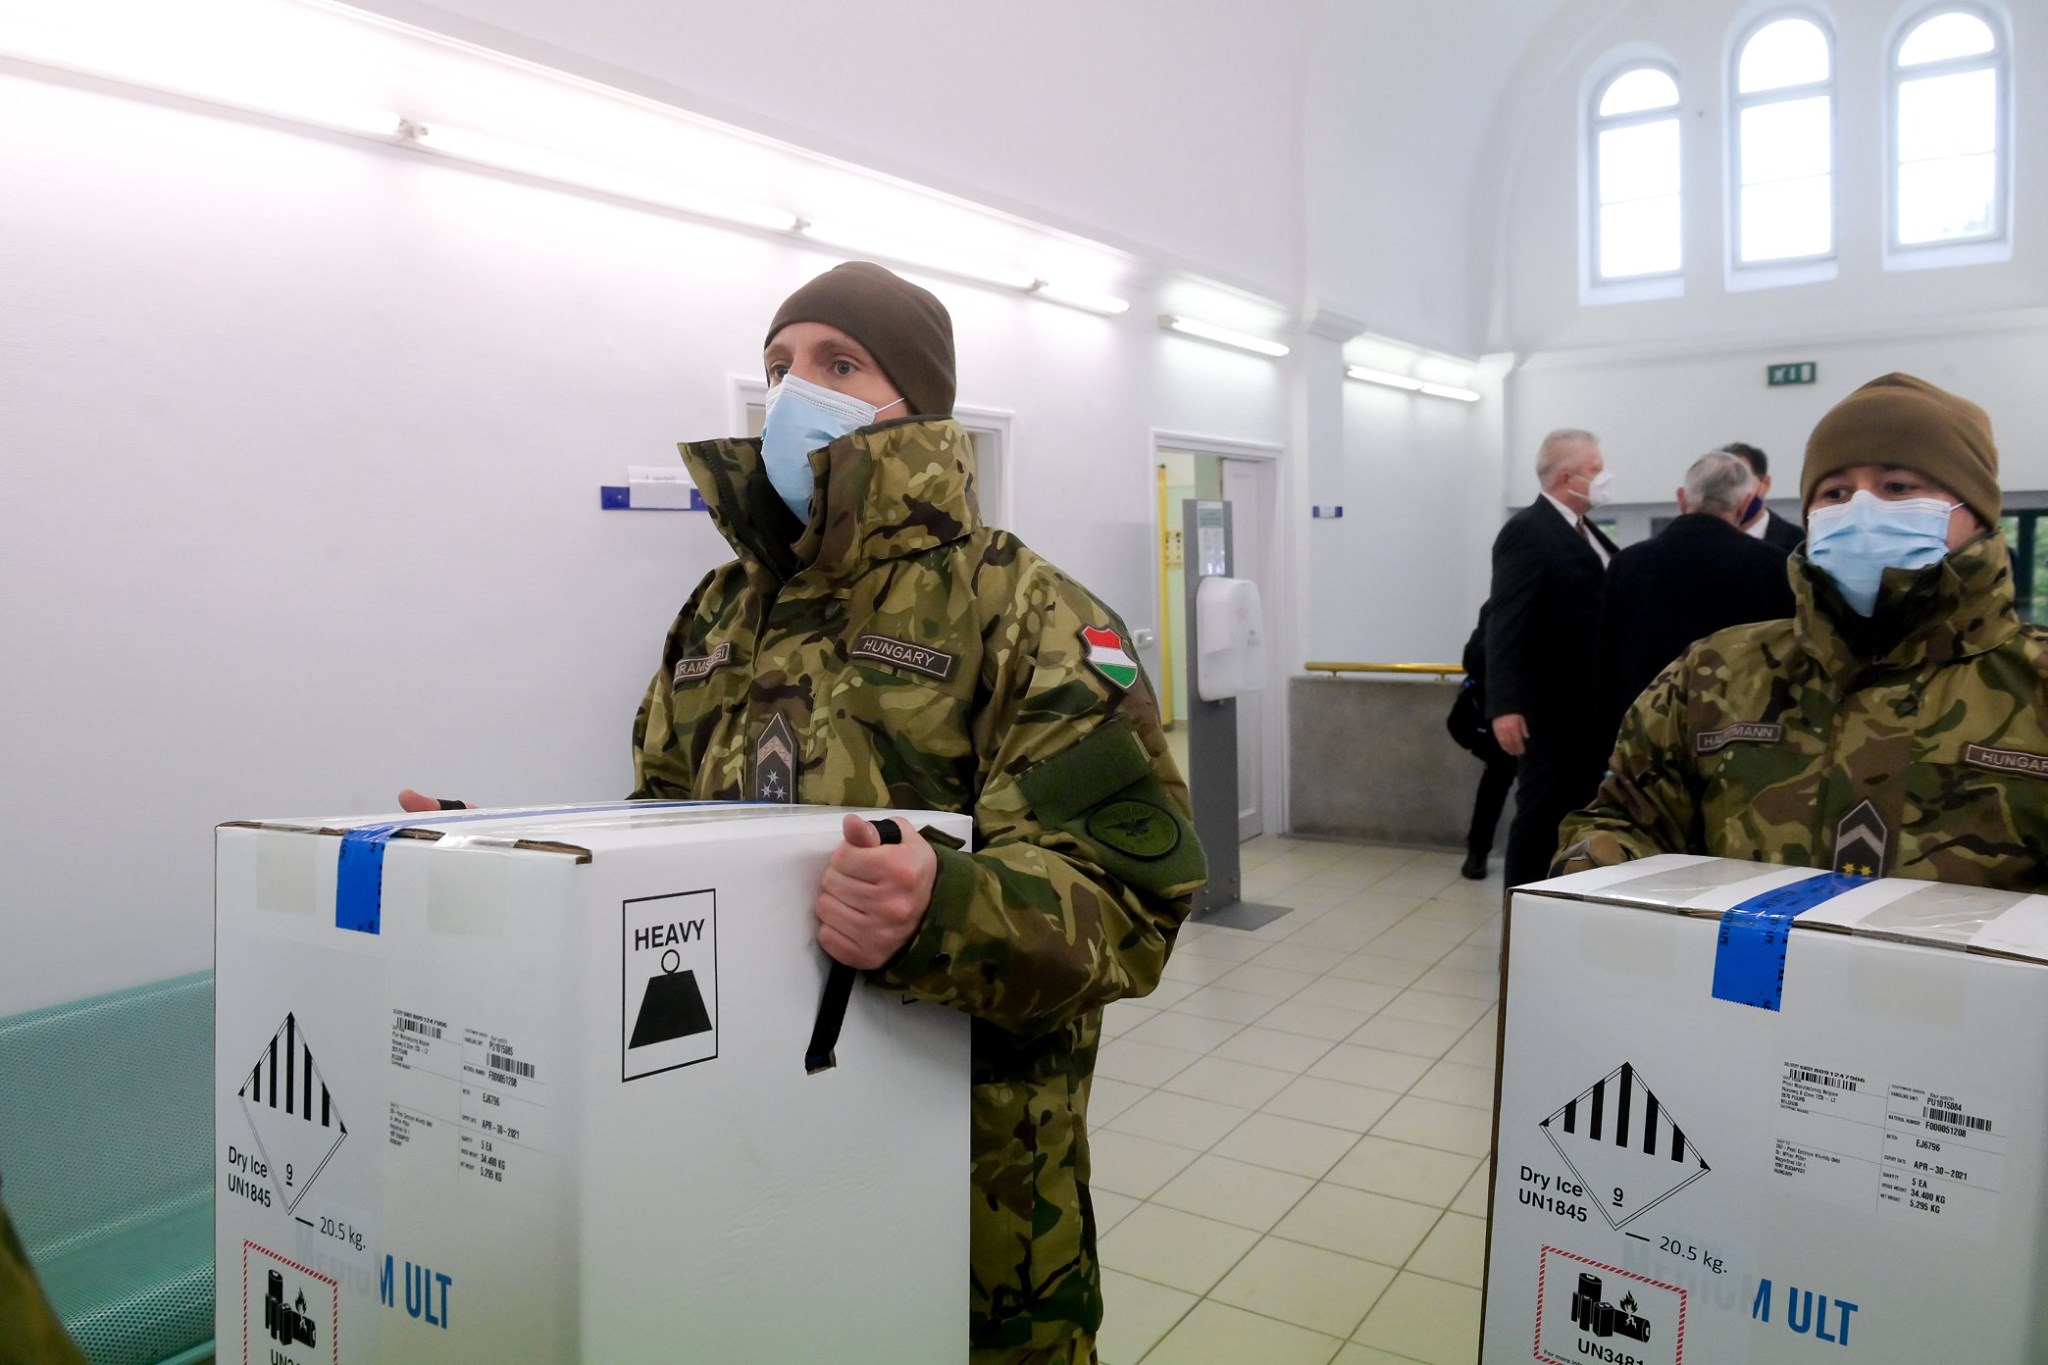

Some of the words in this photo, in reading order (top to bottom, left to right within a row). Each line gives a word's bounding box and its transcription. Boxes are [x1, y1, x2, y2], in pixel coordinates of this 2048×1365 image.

[863, 638, 935, 667] HUNGARY
[634, 918, 705, 951] HEAVY
[1915, 1139, 1941, 1152] EJ6796
[228, 1145, 248, 1174] Dry
[250, 1155, 268, 1178] Ice
[285, 1163, 293, 1182] 9
[228, 1173, 271, 1208] UN1845
[1520, 1165, 1551, 1190] Dry
[1556, 1175, 1583, 1197] Ice
[1613, 1187, 1624, 1202] 9
[1918, 1179, 1928, 1189] EA
[1518, 1188, 1588, 1223] UN1845
[1930, 1203, 1940, 1214] KG
[1935, 1194, 1946, 1204] KG
[320, 1216, 345, 1240] 20.5
[1659, 1235, 1697, 1262] 20.5
[405, 1261, 452, 1329] ULT
[1787, 1286, 1859, 1346] ULT
